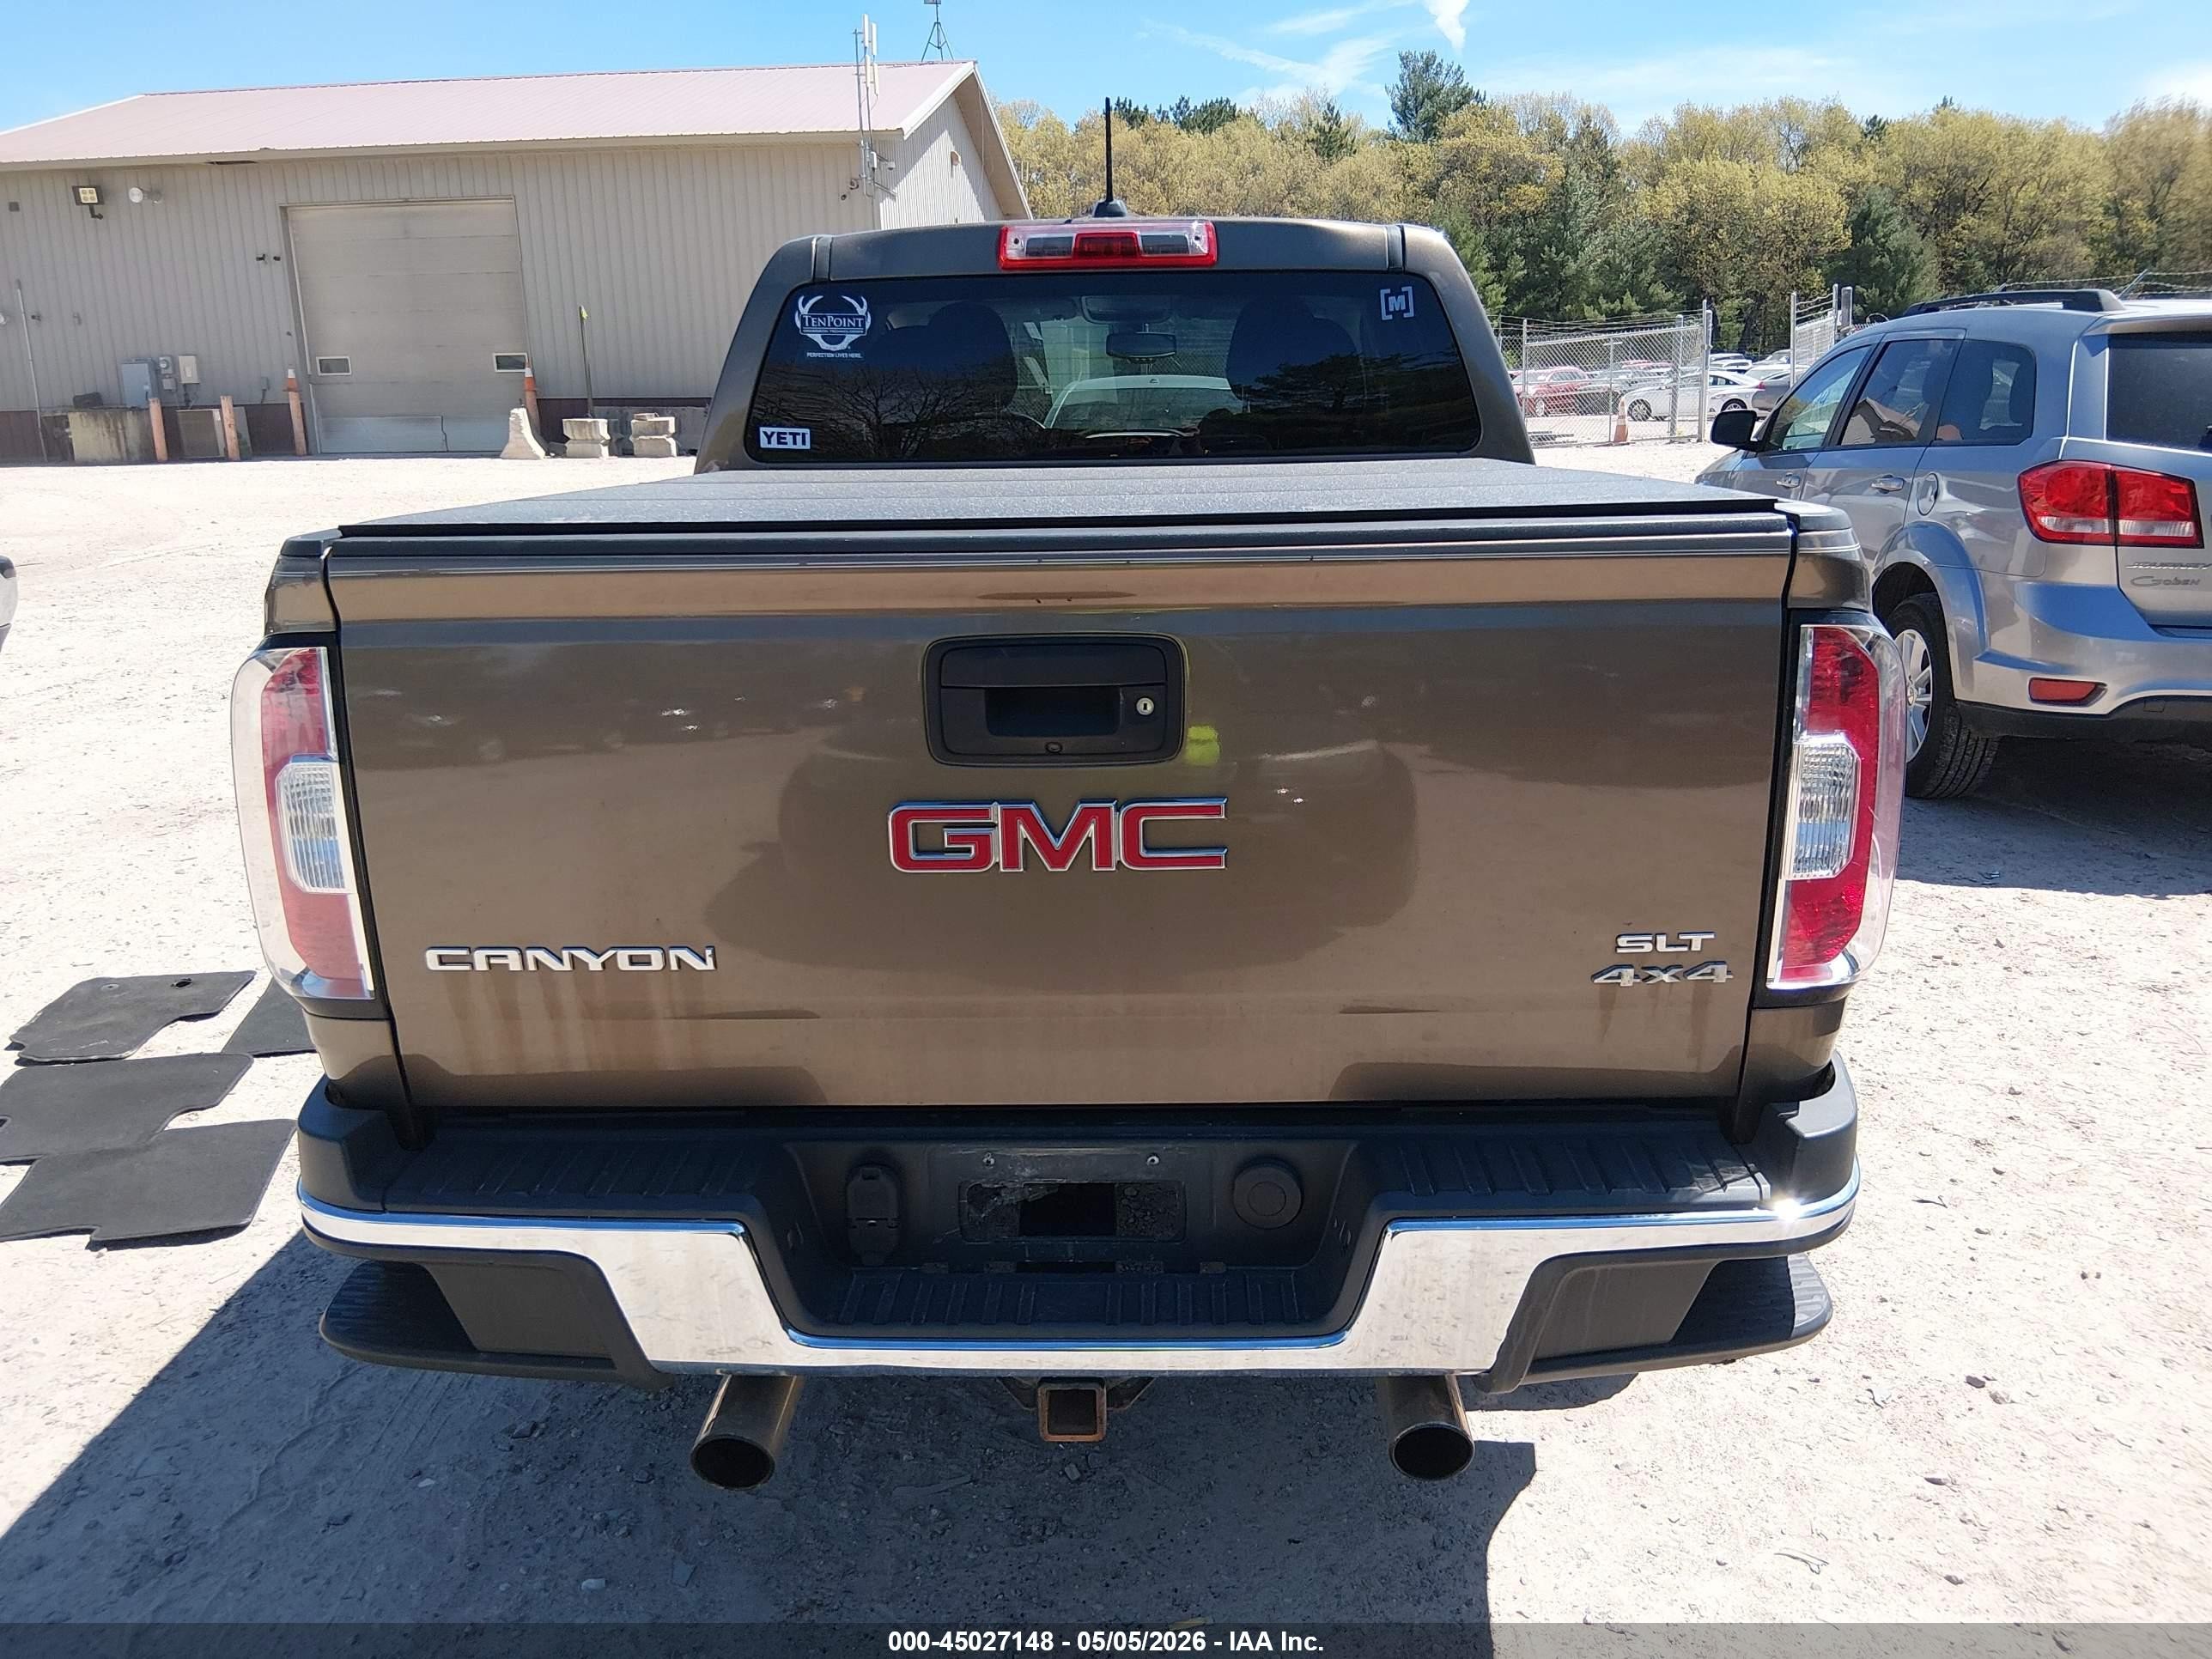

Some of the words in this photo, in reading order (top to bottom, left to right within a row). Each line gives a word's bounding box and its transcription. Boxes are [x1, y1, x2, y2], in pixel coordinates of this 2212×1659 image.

[762, 430, 807, 446] YETI
[887, 797, 1228, 872] GMC
[1615, 931, 1716, 953] SLT
[425, 946, 716, 971] CANYON
